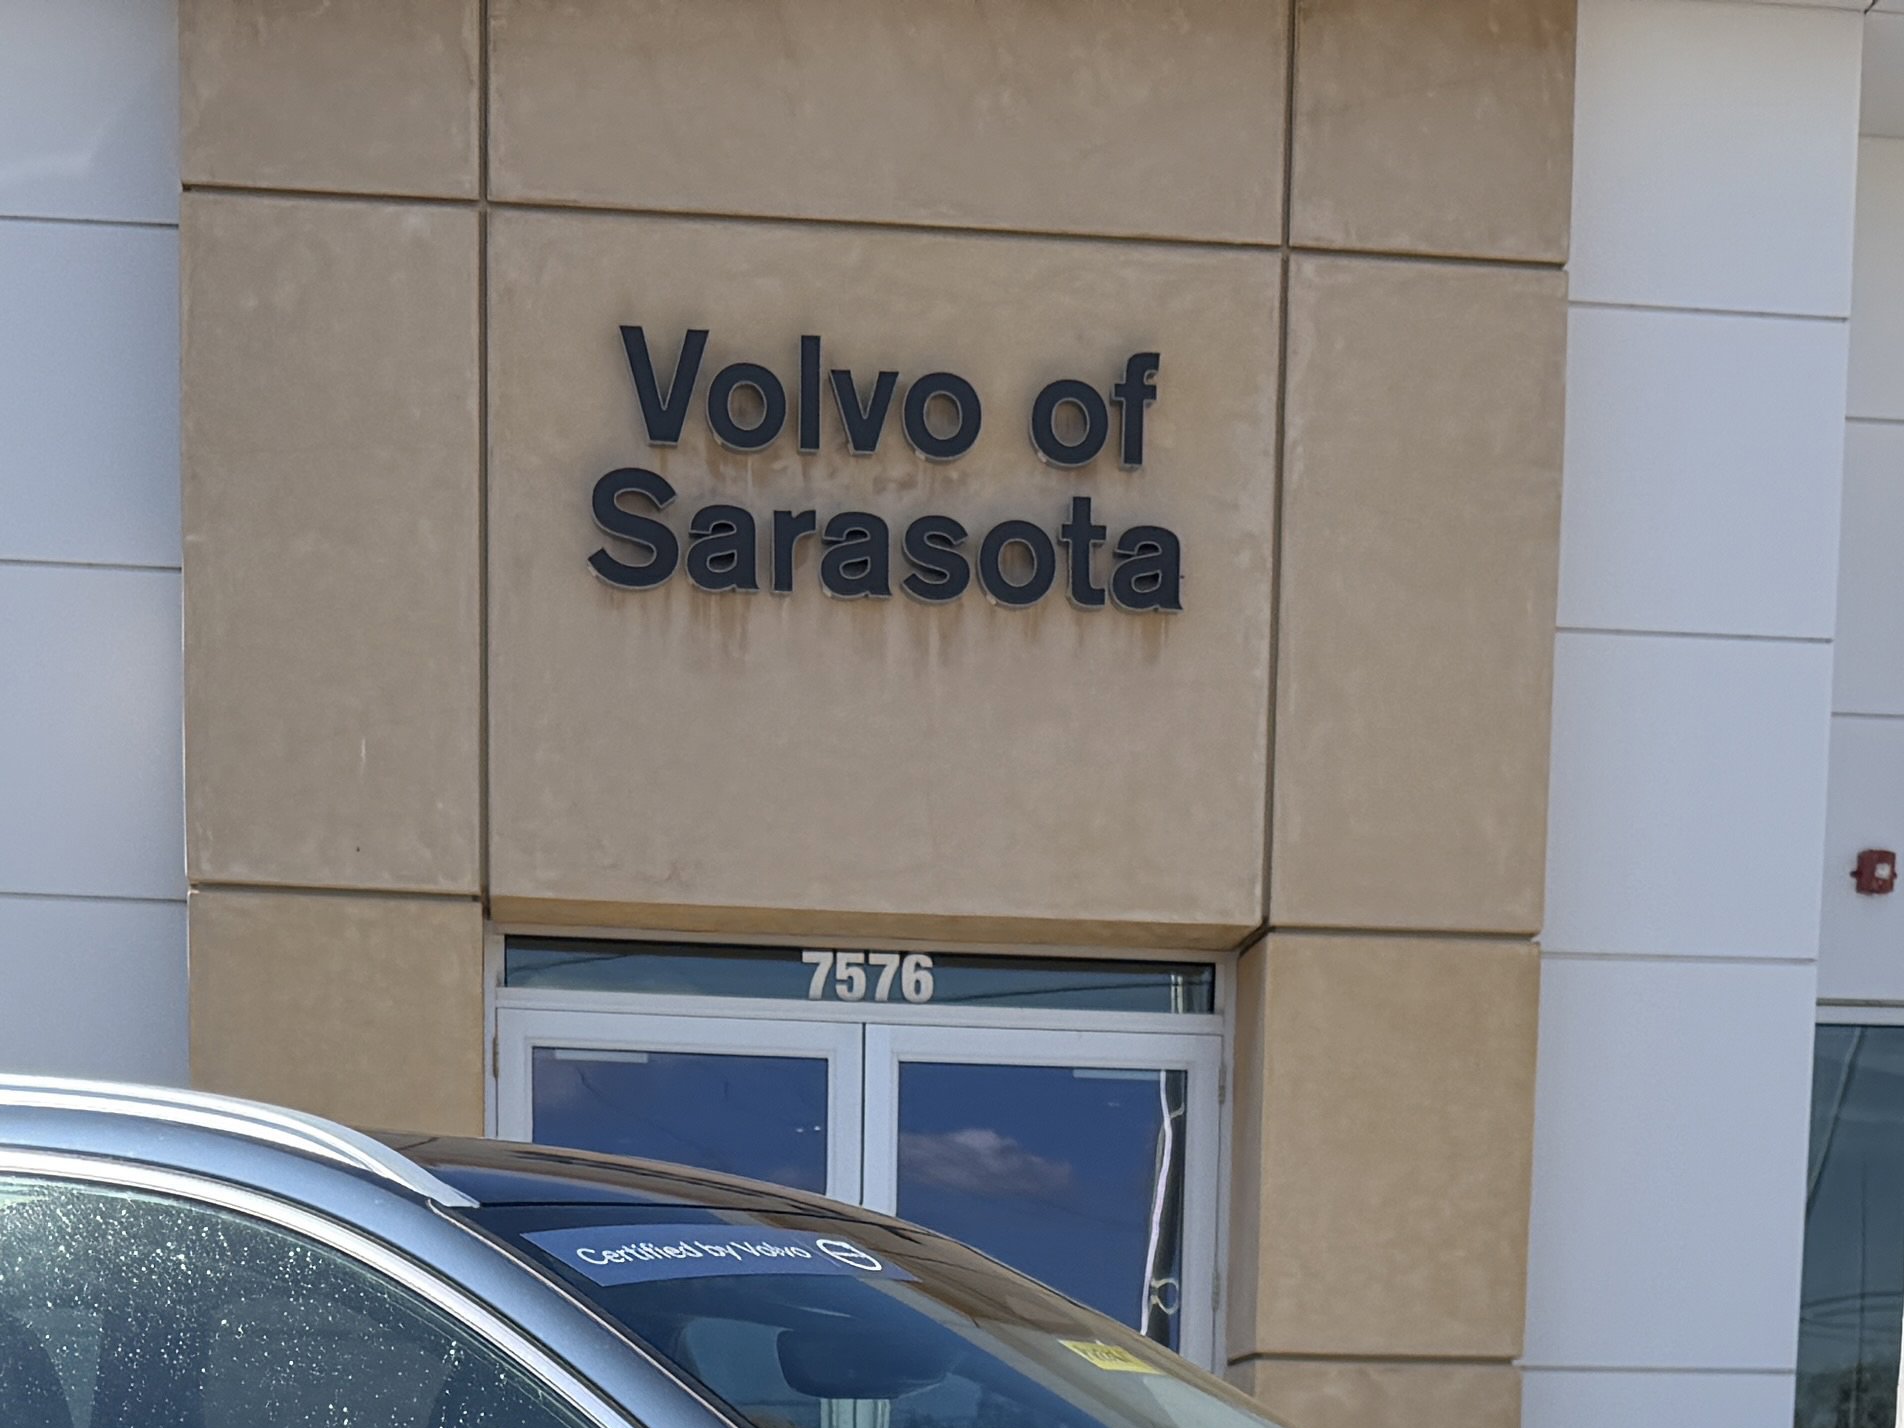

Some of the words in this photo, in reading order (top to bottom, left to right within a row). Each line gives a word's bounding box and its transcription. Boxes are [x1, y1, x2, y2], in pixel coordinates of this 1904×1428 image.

[619, 325, 982, 462] Volvo
[1029, 352, 1161, 470] of
[587, 467, 1184, 613] Sarasota
[801, 950, 935, 1002] 7576
[576, 1240, 700, 1266] Certified
[695, 1240, 742, 1261] by
[731, 1240, 813, 1260] Volvo
